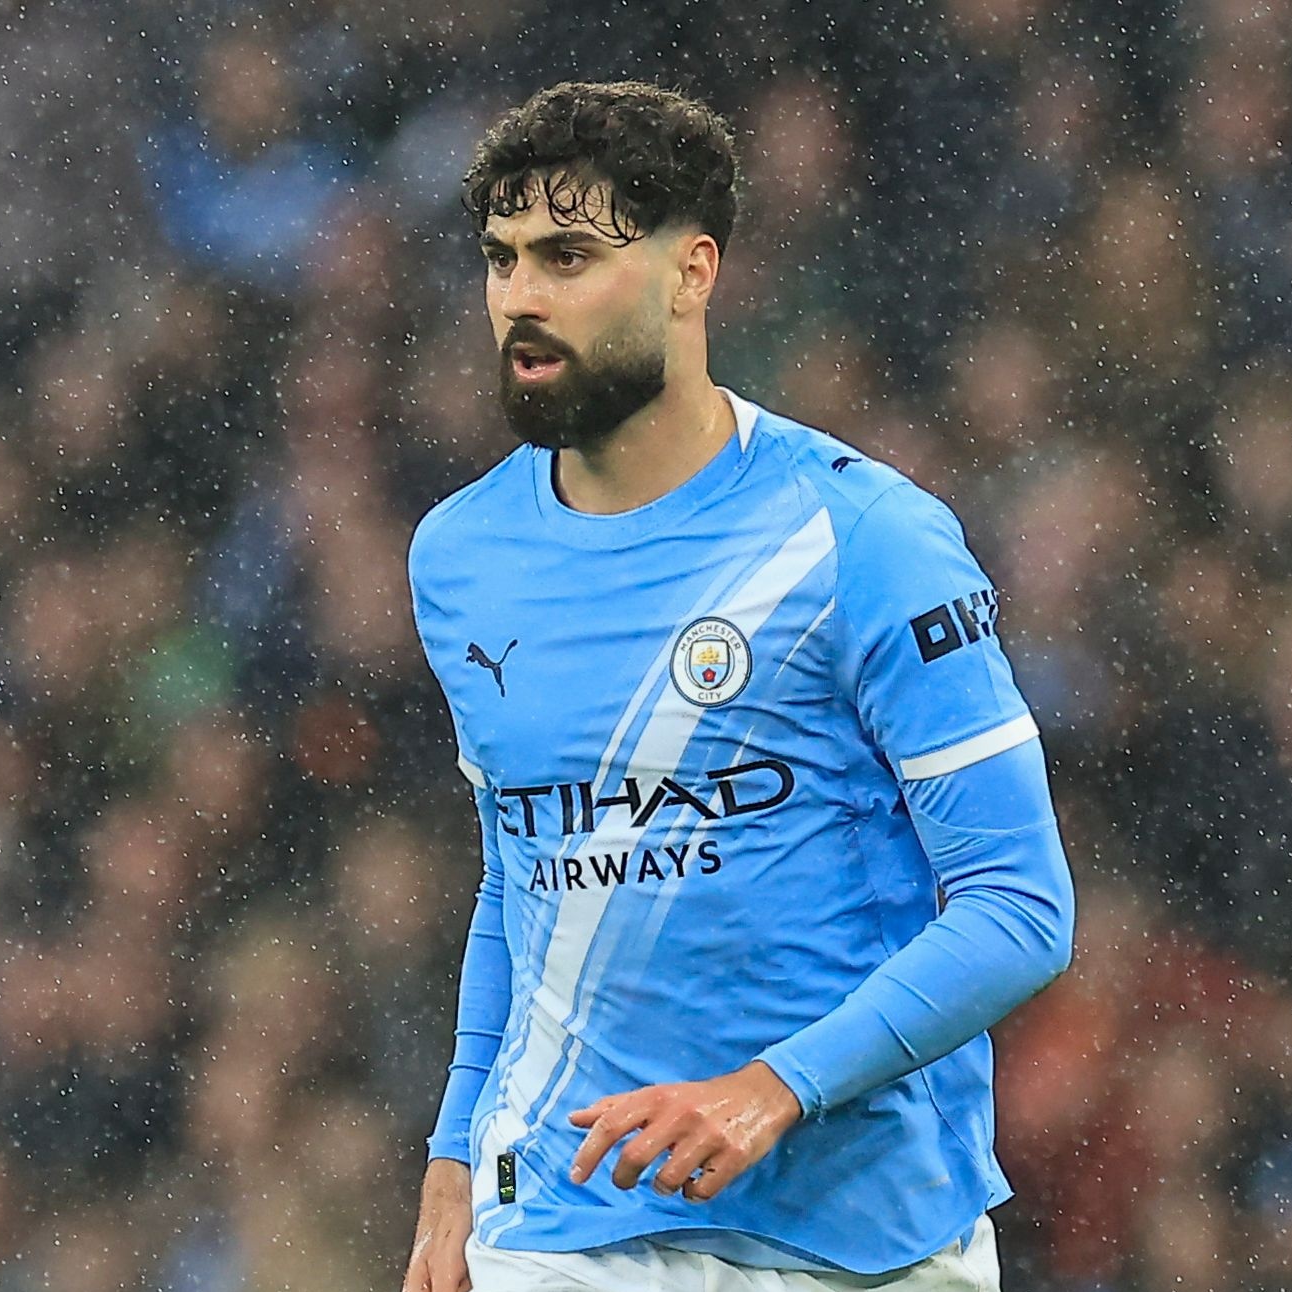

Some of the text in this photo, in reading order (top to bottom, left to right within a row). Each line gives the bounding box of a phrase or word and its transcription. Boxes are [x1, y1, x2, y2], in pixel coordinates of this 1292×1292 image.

[680, 624, 742, 652] MANCHESTER
[698, 692, 722, 700] CITY
[529, 840, 722, 891] AIRWAYS
